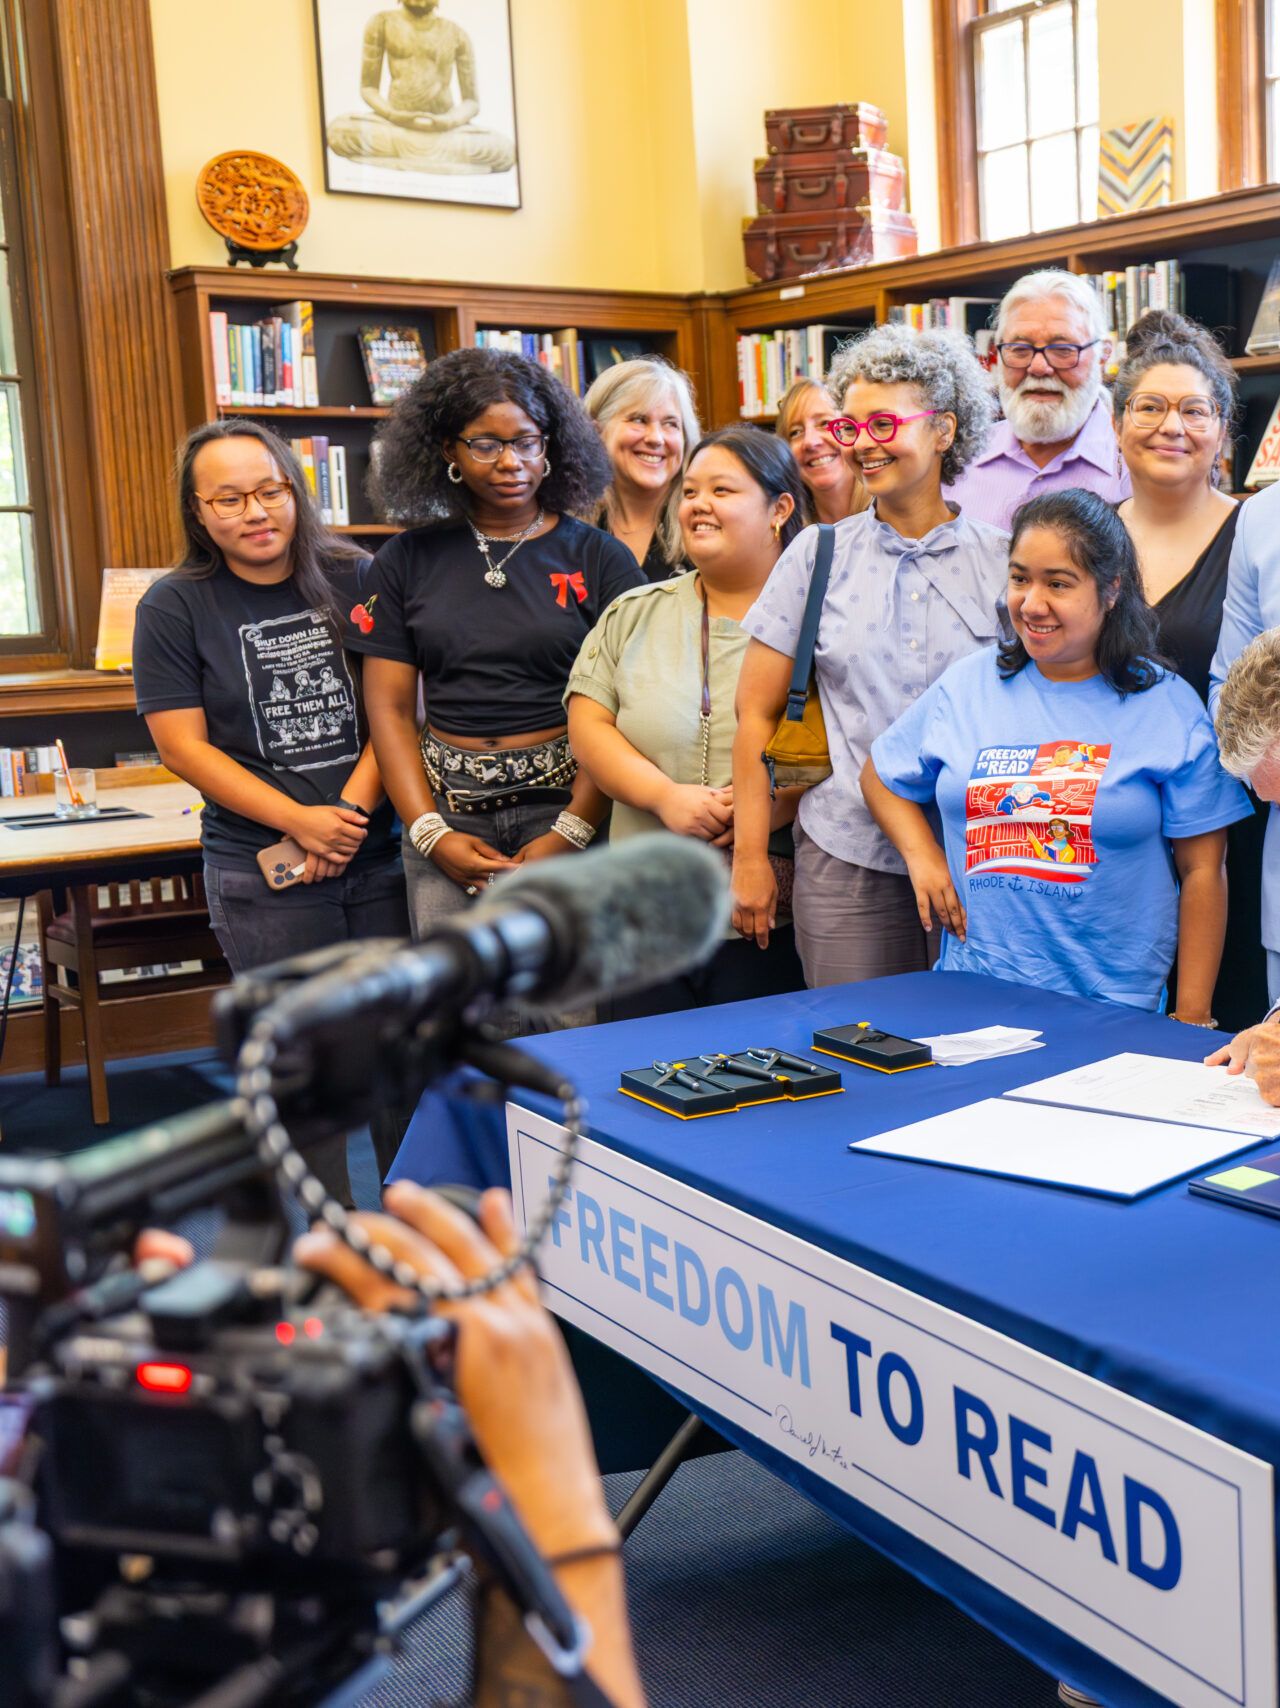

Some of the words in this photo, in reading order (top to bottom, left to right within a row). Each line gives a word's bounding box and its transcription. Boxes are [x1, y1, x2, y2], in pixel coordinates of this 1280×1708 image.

[253, 637, 277, 648] SHUT
[278, 630, 307, 644] DOWN
[265, 704, 293, 719] FREE
[294, 698, 325, 714] THEM
[328, 692, 348, 708] ALL
[978, 748, 1038, 762] FREEDOM
[976, 762, 989, 771] TO
[986, 760, 1030, 776] READ
[969, 876, 1005, 893] RHODE
[1026, 879, 1084, 900] ISLAND
[547, 1175, 812, 1390] FREEDOM
[829, 1320, 925, 1447] TO
[952, 1383, 1183, 1592] READ
